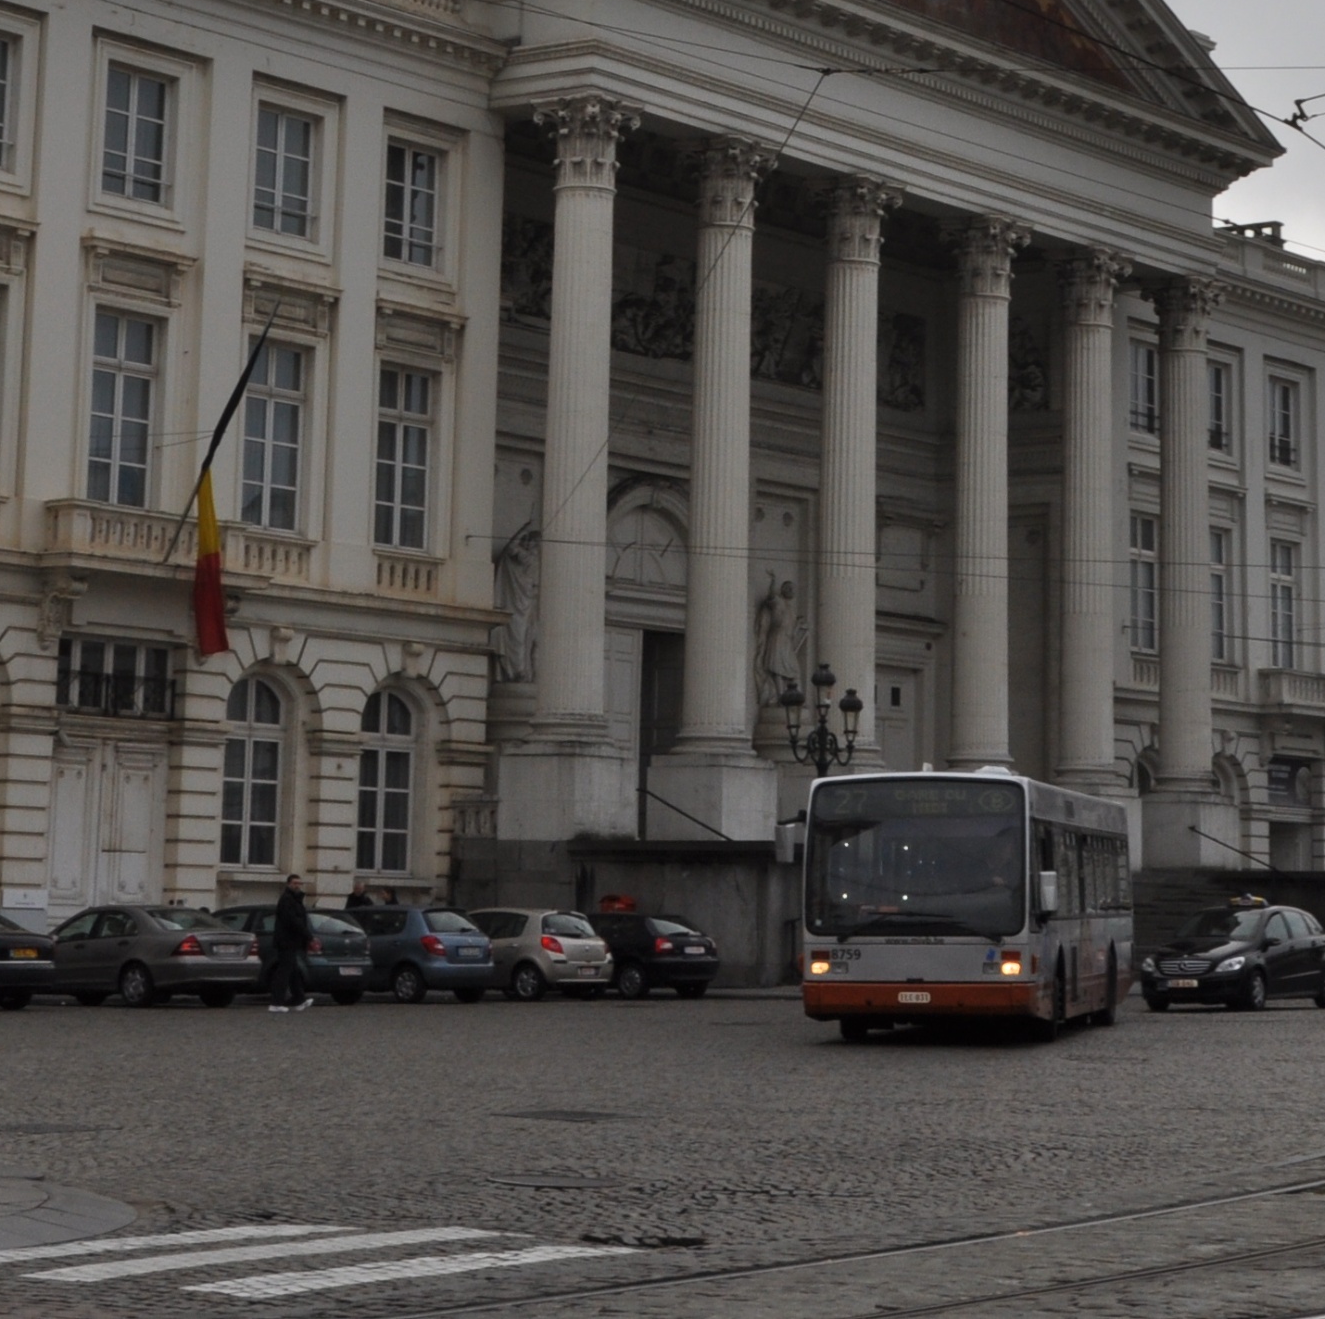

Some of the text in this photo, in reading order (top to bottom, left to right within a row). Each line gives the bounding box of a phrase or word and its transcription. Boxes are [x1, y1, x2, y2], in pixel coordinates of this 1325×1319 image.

[834, 788, 869, 815] 27
[893, 788, 940, 802] GARE
[943, 788, 968, 801] DU
[830, 948, 862, 961] 8759
